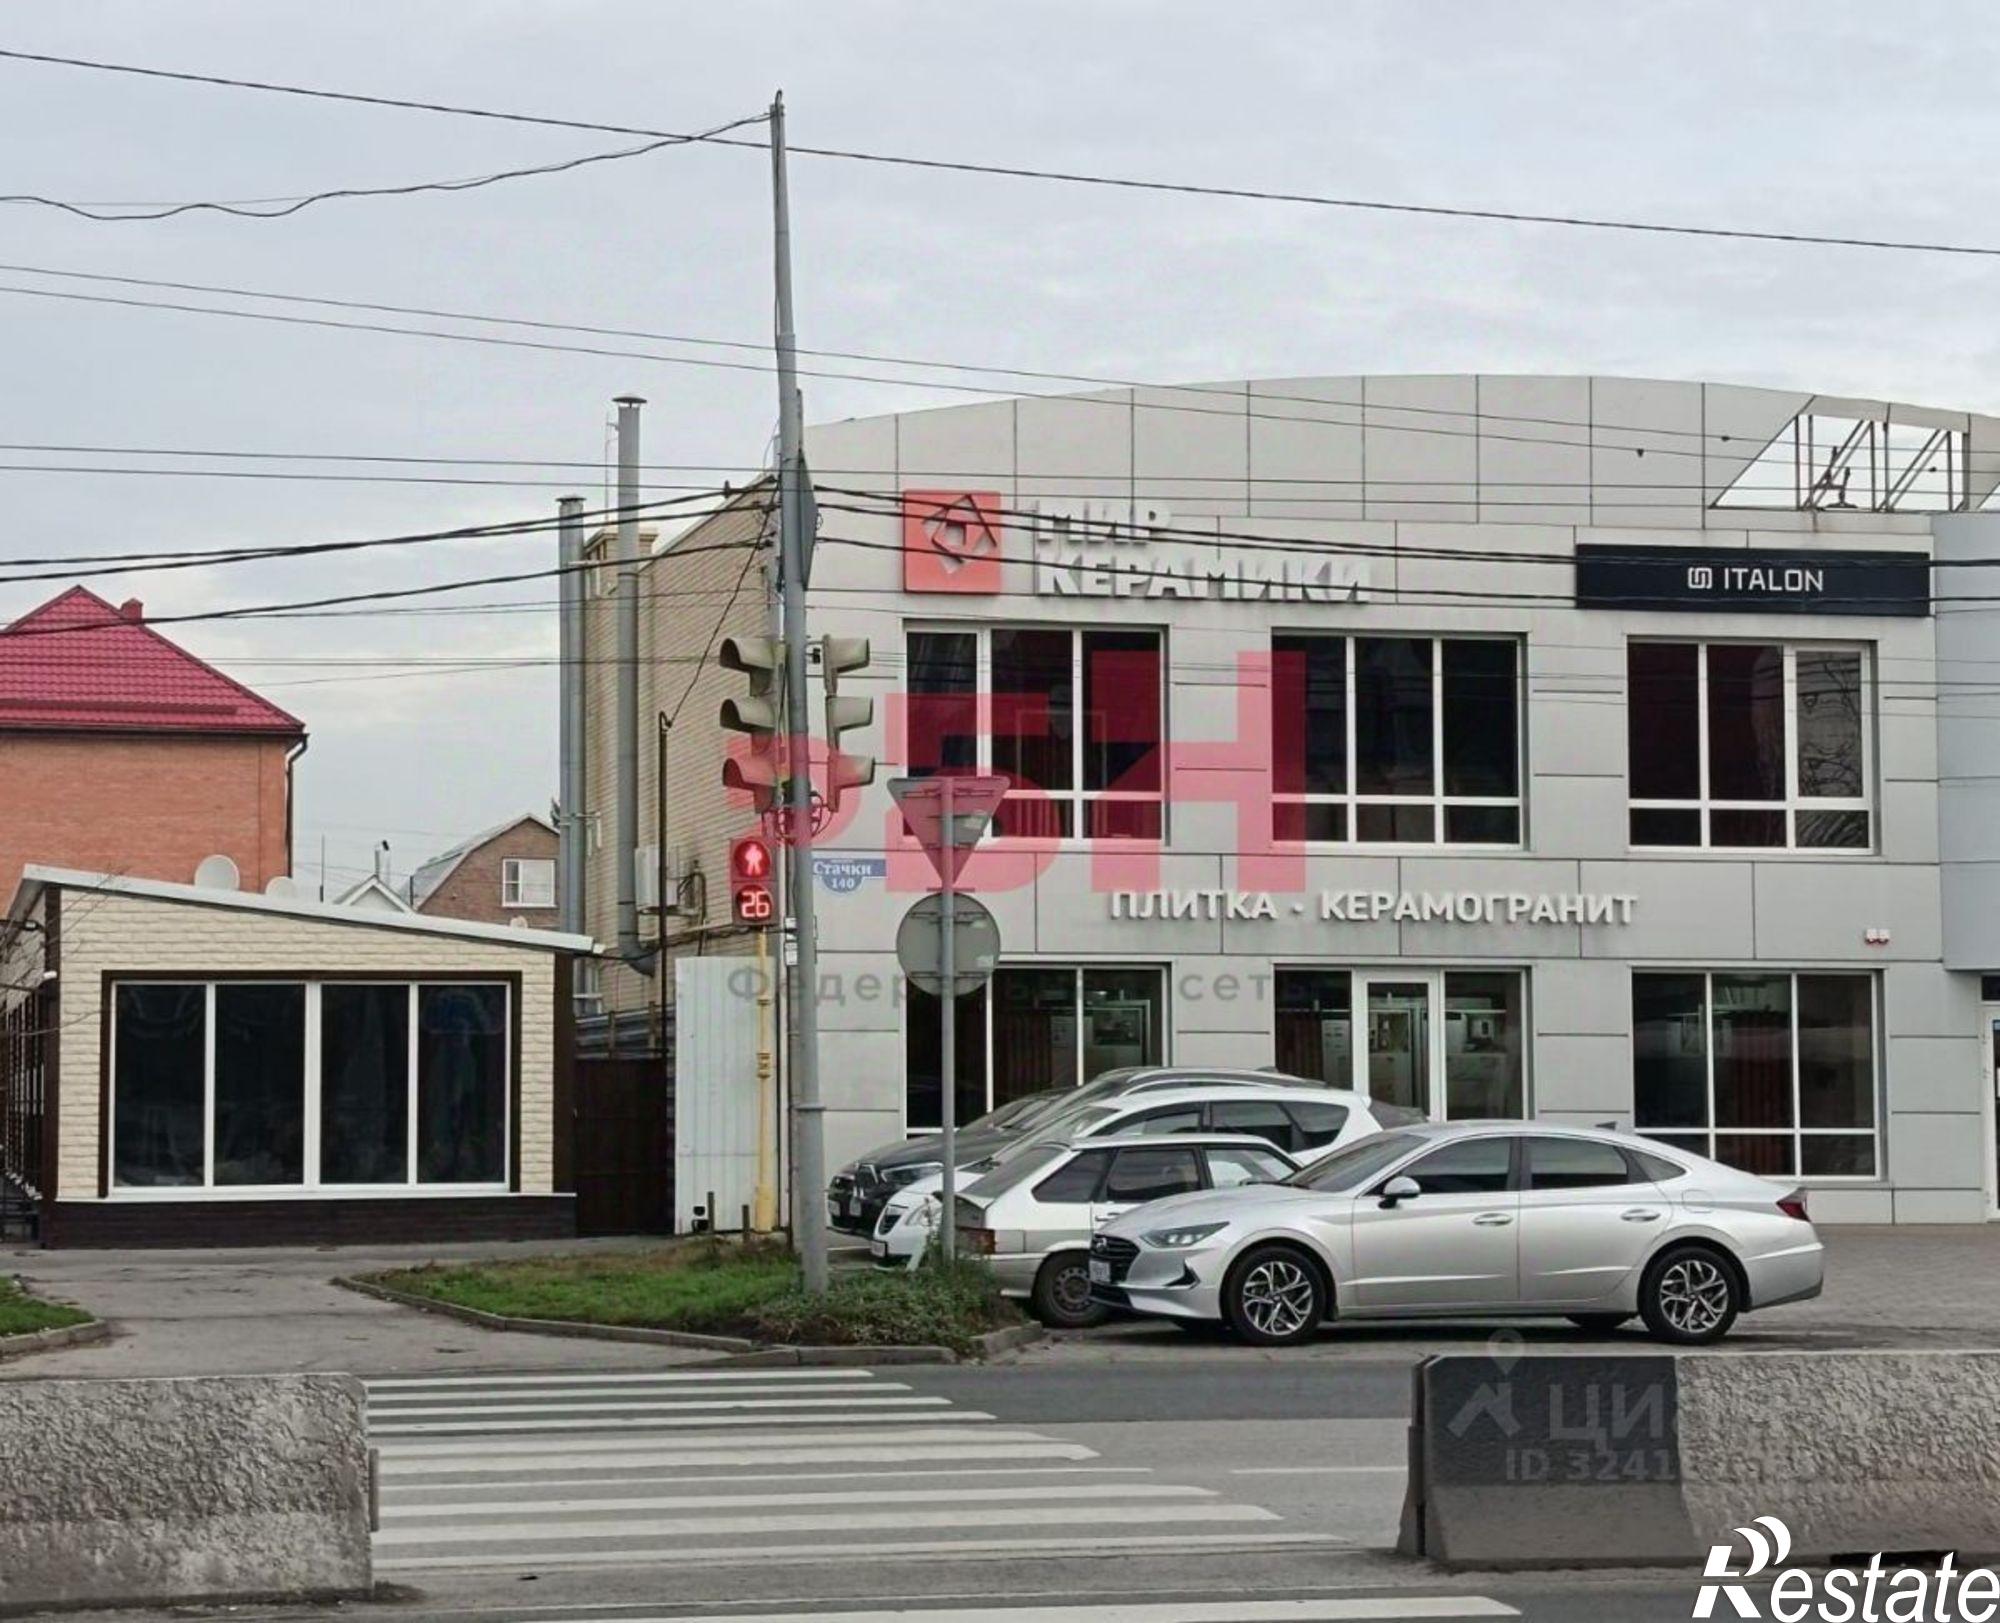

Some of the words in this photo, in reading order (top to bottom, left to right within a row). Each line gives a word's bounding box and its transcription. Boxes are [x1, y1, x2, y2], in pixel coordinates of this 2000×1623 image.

[1037, 552, 1372, 603] КЕРАМИКИ
[1723, 568, 1825, 593] ITALON
[812, 861, 872, 876] Стачки
[831, 878, 856, 890] 140
[741, 891, 770, 918] 26
[1111, 889, 1276, 921] ПЛИТКА
[1321, 892, 1638, 927] КЕРАМОГРАНИТ
